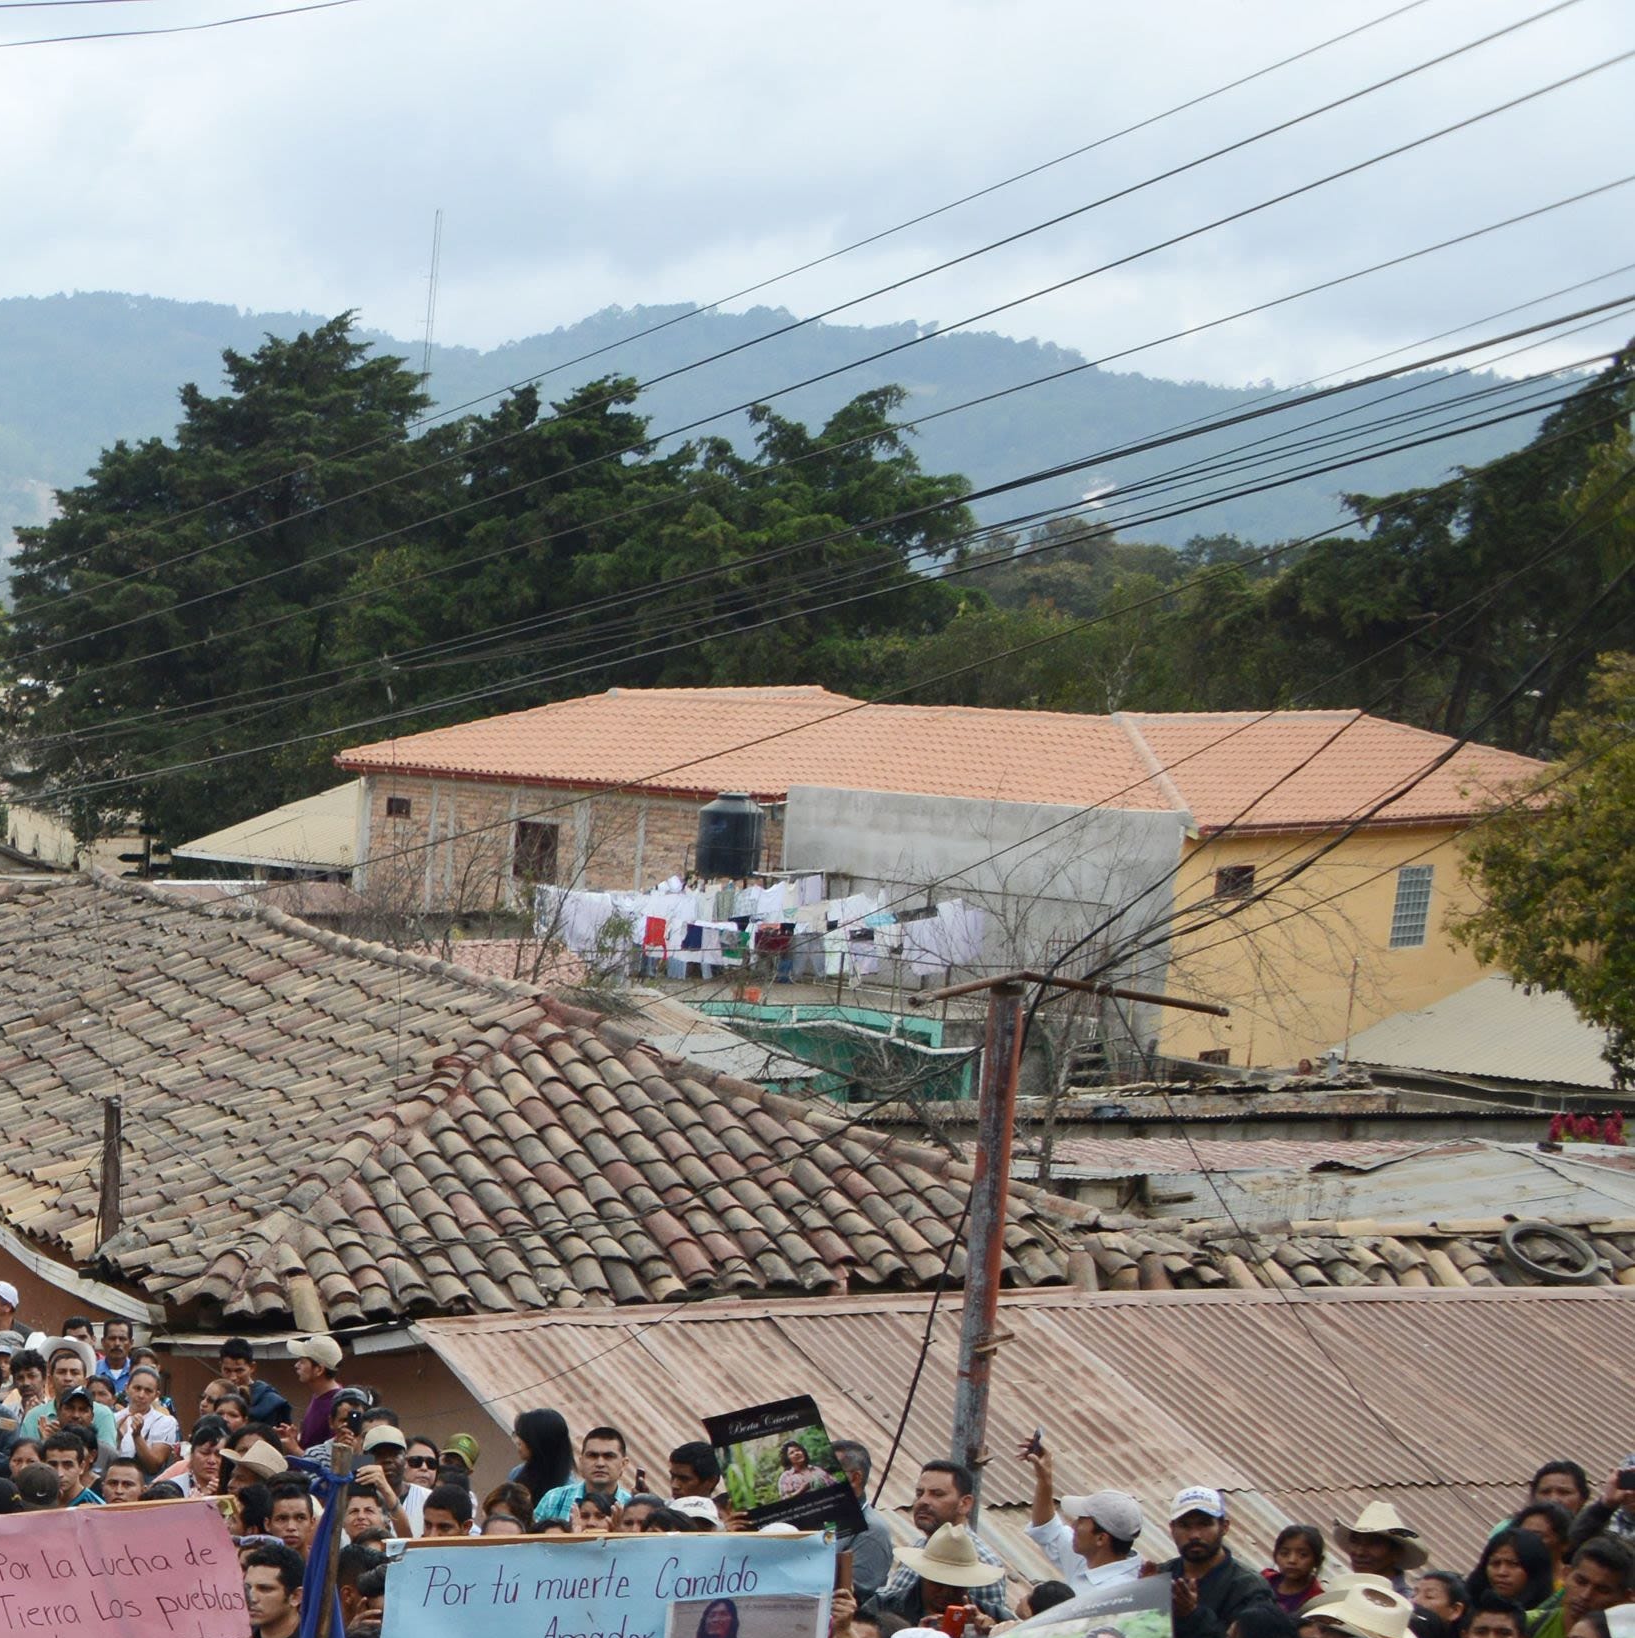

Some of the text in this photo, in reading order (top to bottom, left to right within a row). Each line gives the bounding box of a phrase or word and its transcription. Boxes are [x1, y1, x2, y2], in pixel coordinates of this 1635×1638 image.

[729, 1421, 759, 1435] Berta
[185, 1538, 217, 1566] de
[423, 1556, 758, 1607] Por tú muerte Candido
[91, 1591, 142, 1621] Los
[156, 1580, 244, 1631] pueblos
